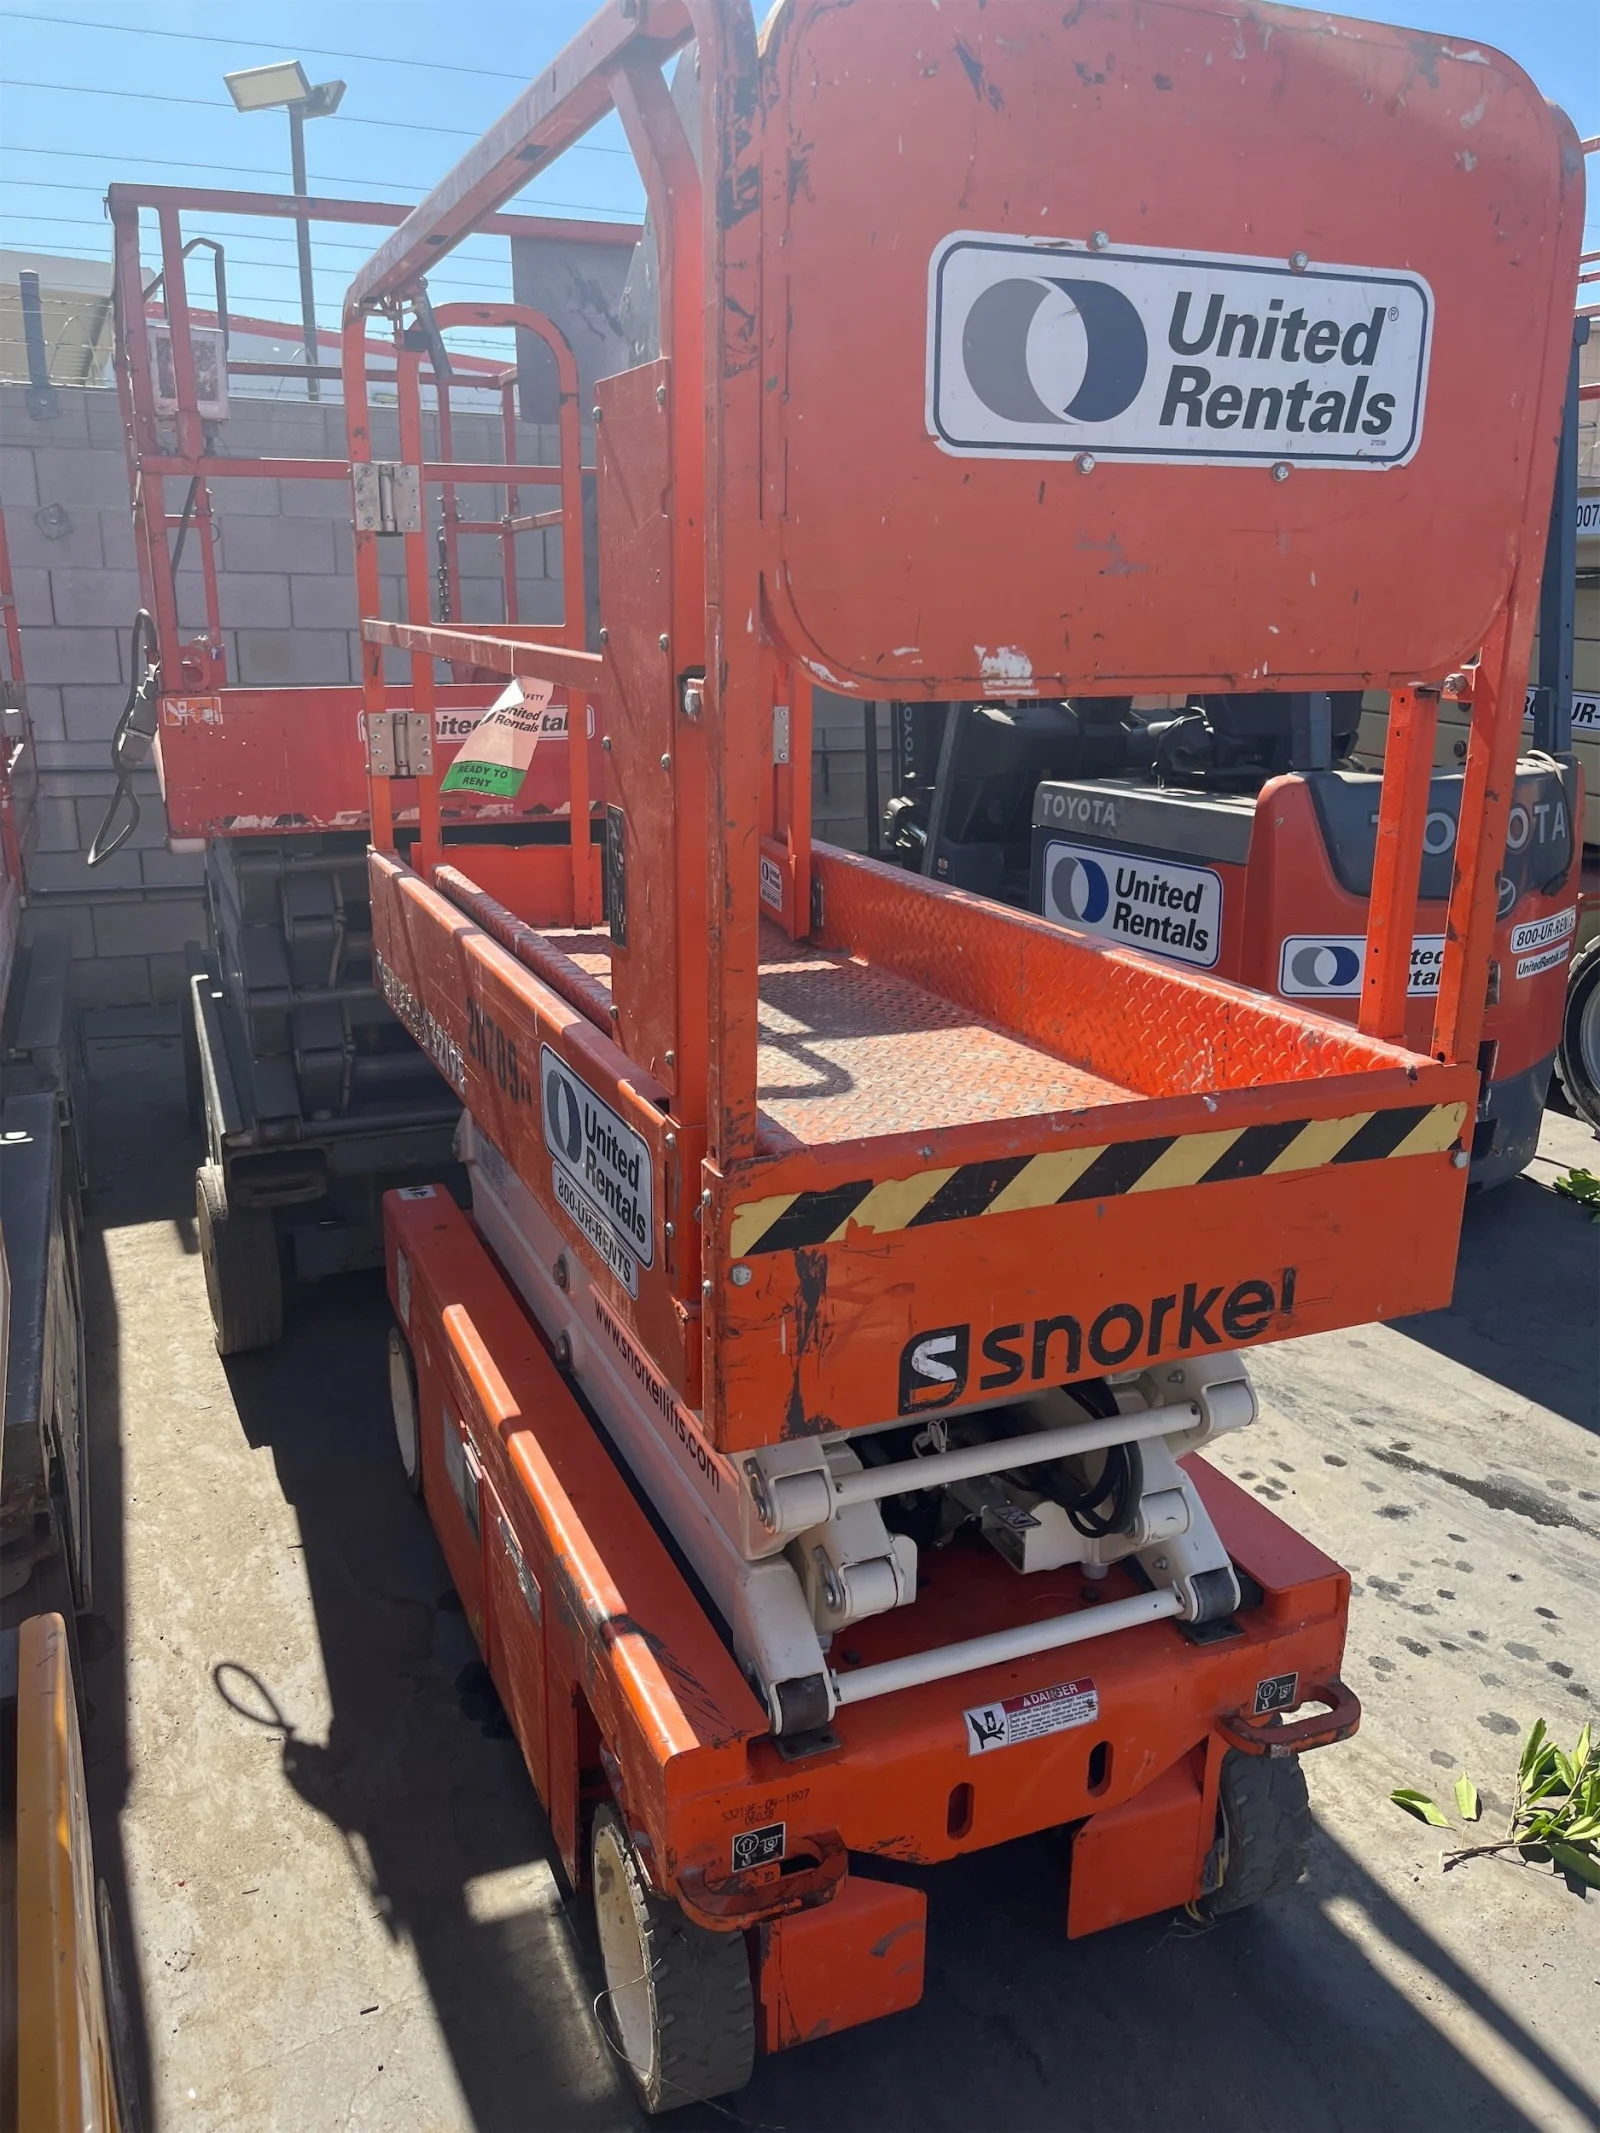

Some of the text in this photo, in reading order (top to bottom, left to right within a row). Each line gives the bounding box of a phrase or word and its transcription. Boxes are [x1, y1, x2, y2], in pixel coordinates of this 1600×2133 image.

[1168, 292, 1387, 366] United
[1159, 365, 1396, 436] Rentals
[495, 714, 540, 733] Rentals
[904, 702, 914, 766] TOYO
[458, 765, 508, 779] READY TO
[462, 777, 492, 788] RENT
[1042, 793, 1116, 827] TOYOTA
[1115, 868, 1204, 914] United
[1112, 902, 1209, 951] Rentals
[585, 1103, 640, 1192] United
[585, 1146, 646, 1244] Rentals
[558, 1177, 631, 1283] 800-UR-RENTS
[980, 1266, 1297, 1391] snorkel
[595, 1300, 721, 1494] www.snorkellifts.com
